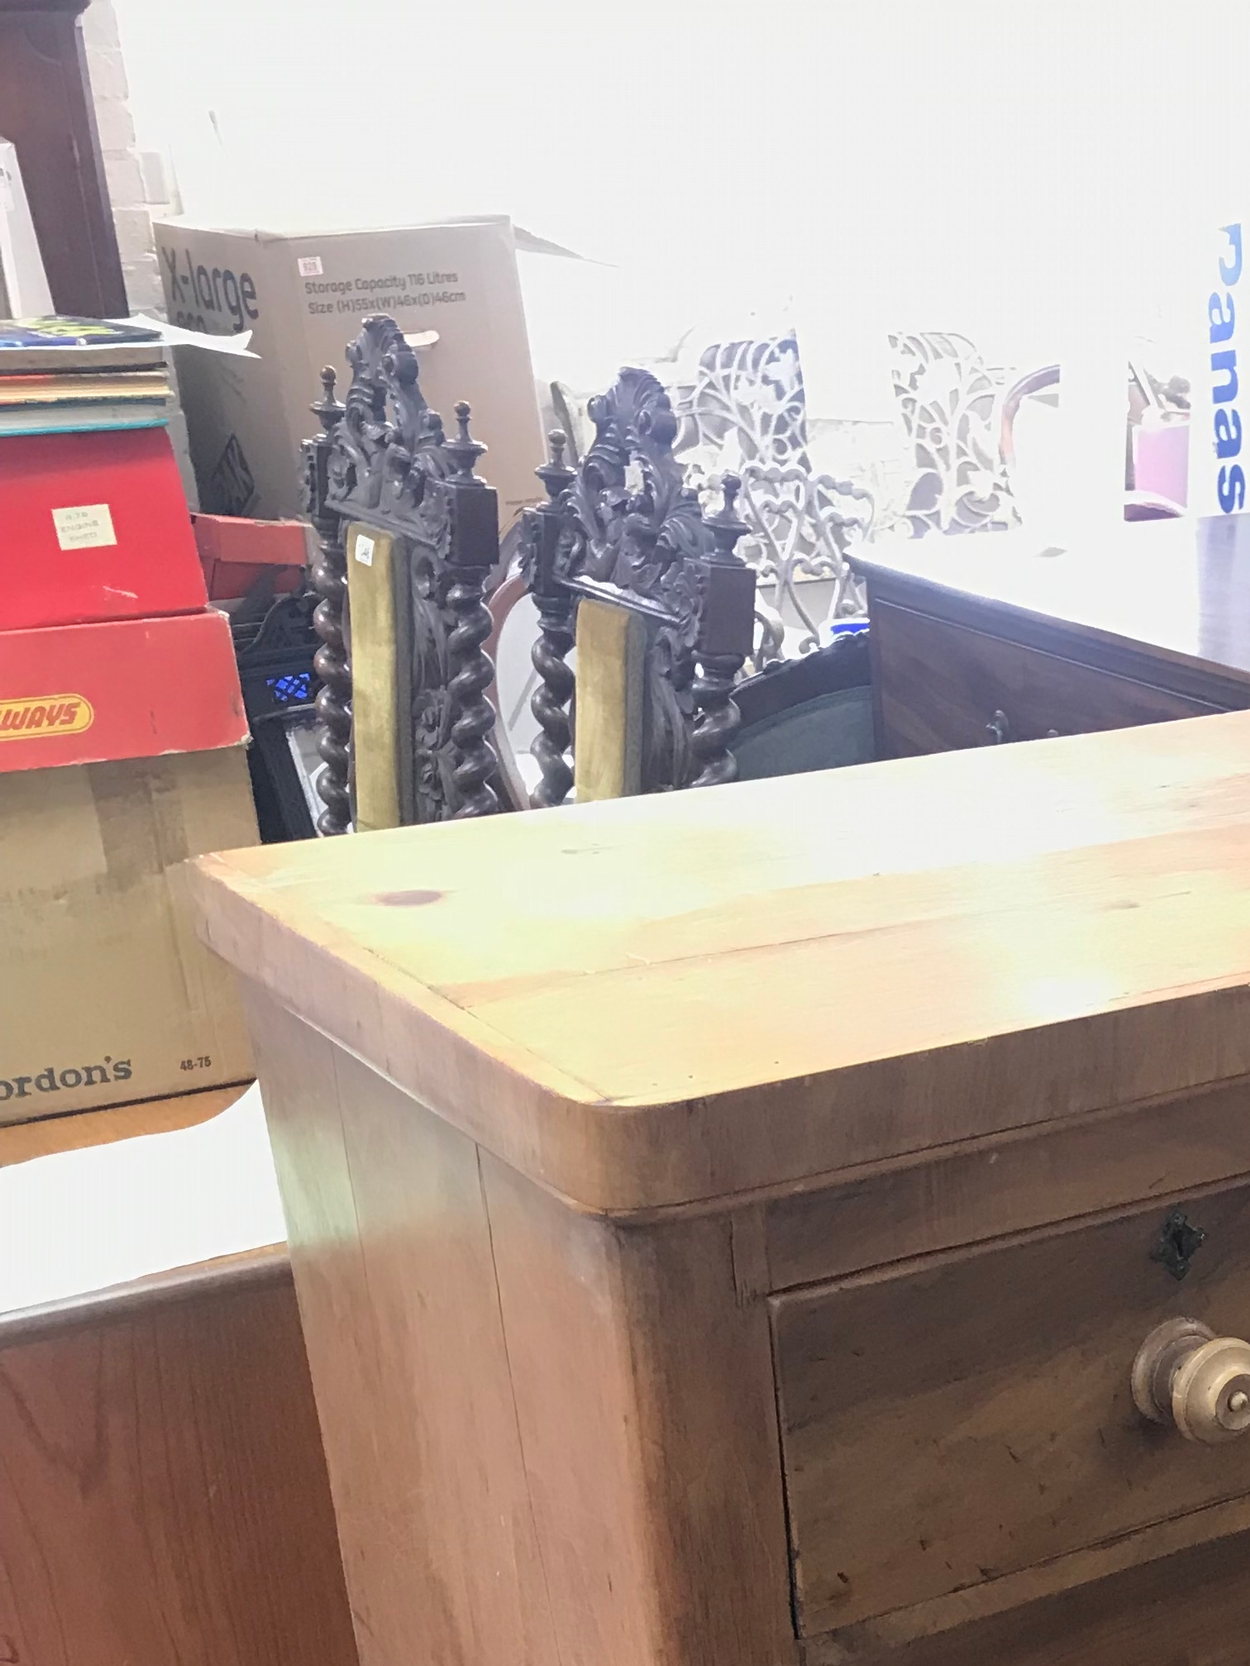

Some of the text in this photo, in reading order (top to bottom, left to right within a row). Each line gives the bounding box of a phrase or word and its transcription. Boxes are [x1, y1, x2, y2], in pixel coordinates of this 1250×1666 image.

[161, 246, 260, 333] X-large
[304, 280, 353, 296] Storage
[354, 276, 406, 293] Capacity
[426, 270, 459, 285] Litres
[308, 301, 334, 315] Size
